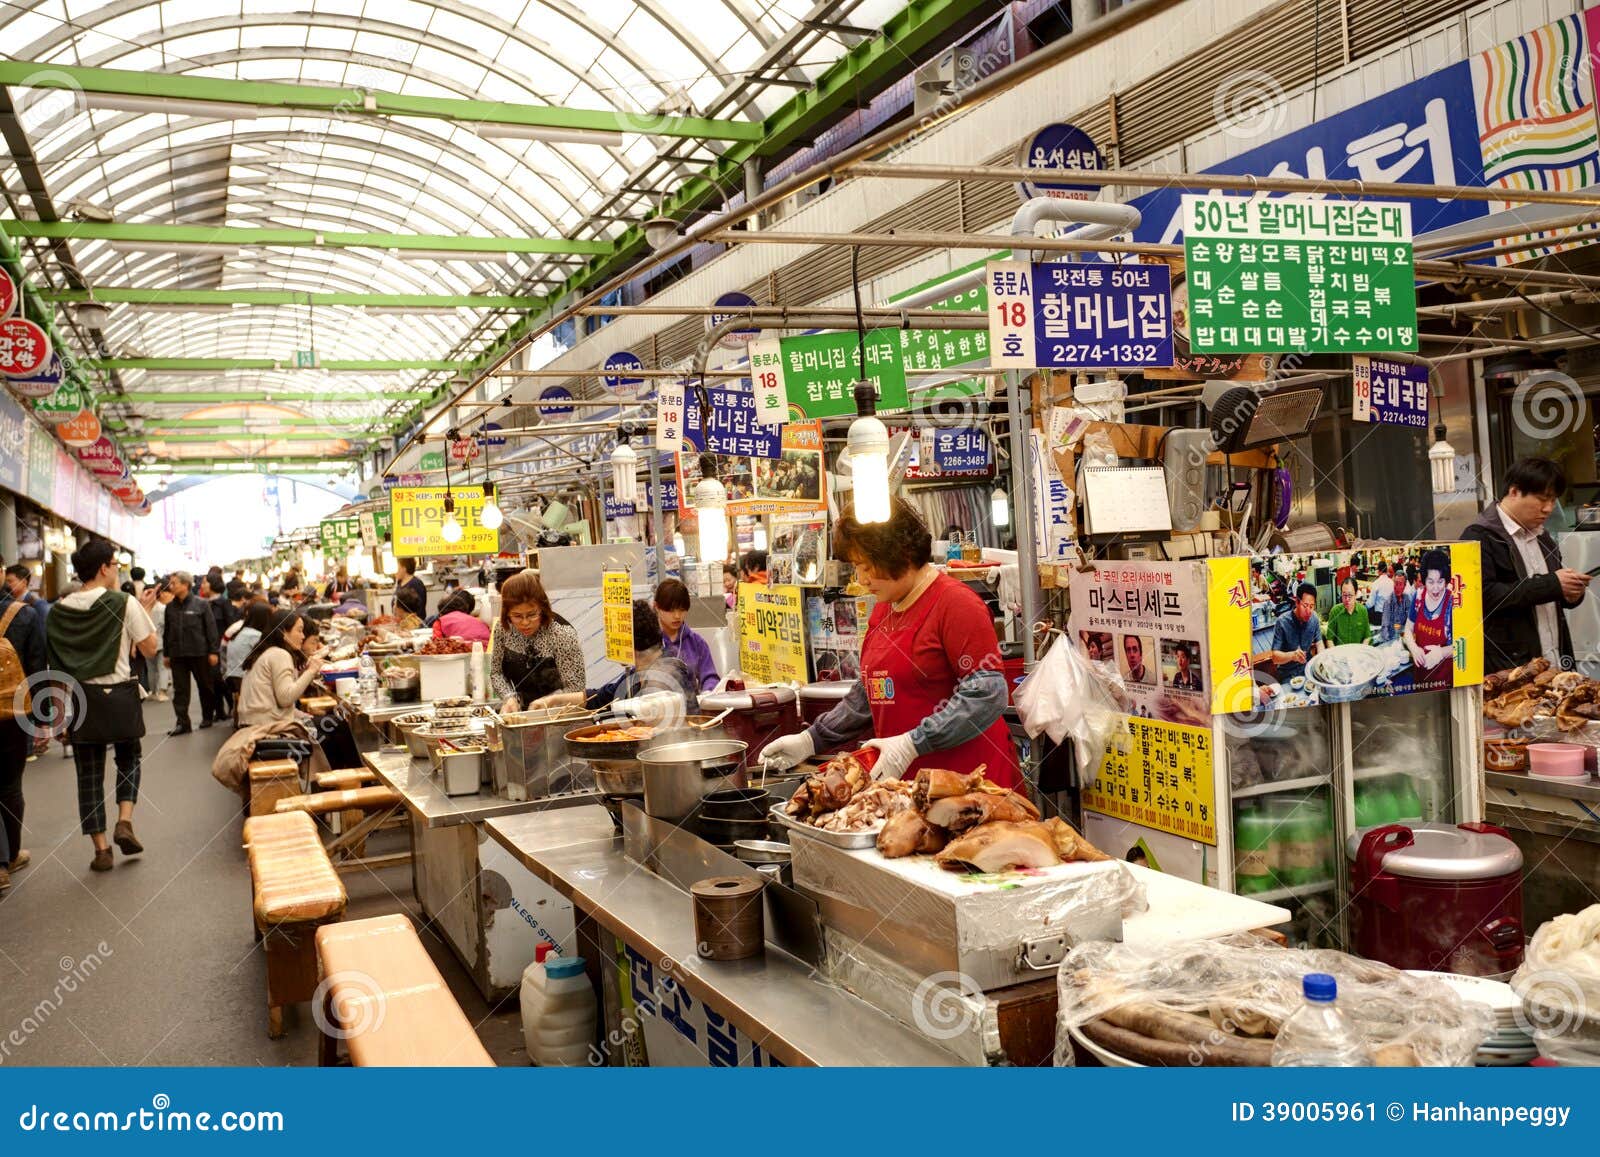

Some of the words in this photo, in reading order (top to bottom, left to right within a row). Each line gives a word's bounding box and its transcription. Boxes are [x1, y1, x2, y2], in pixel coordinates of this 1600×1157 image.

[1194, 200, 1249, 233] 50년
[1258, 201, 1403, 238] 할머니집순대
[993, 271, 1030, 297] 동문A
[1052, 268, 1104, 287] 맛전통
[1112, 270, 1150, 288] 50년
[997, 302, 1026, 328] 18
[1040, 292, 1167, 340] 할머니집
[1002, 334, 1025, 357] 호
[1052, 344, 1158, 363] 2274-1332
[752, 352, 781, 367] 동문A
[789, 347, 846, 373] 할머니집
[851, 343, 894, 367] 순대국
[758, 372, 778, 388] 18
[1355, 380, 1369, 398] 18
[660, 395, 683, 406] 동문B
[764, 395, 781, 410] 호
[1372, 375, 1428, 412] 순대국밥
[662, 412, 677, 423] 18
[1383, 410, 1426, 426] 2274-1332
[663, 428, 677, 440] 호
[939, 434, 986, 453] 윤희네
[707, 435, 771, 457] 순대국밥
[943, 456, 985, 466] 2266-3485
[1121, 571, 1173, 586] 요리서바이벌
[1089, 586, 1183, 618] 마스터셰프
[756, 608, 801, 643] 마약김밥
